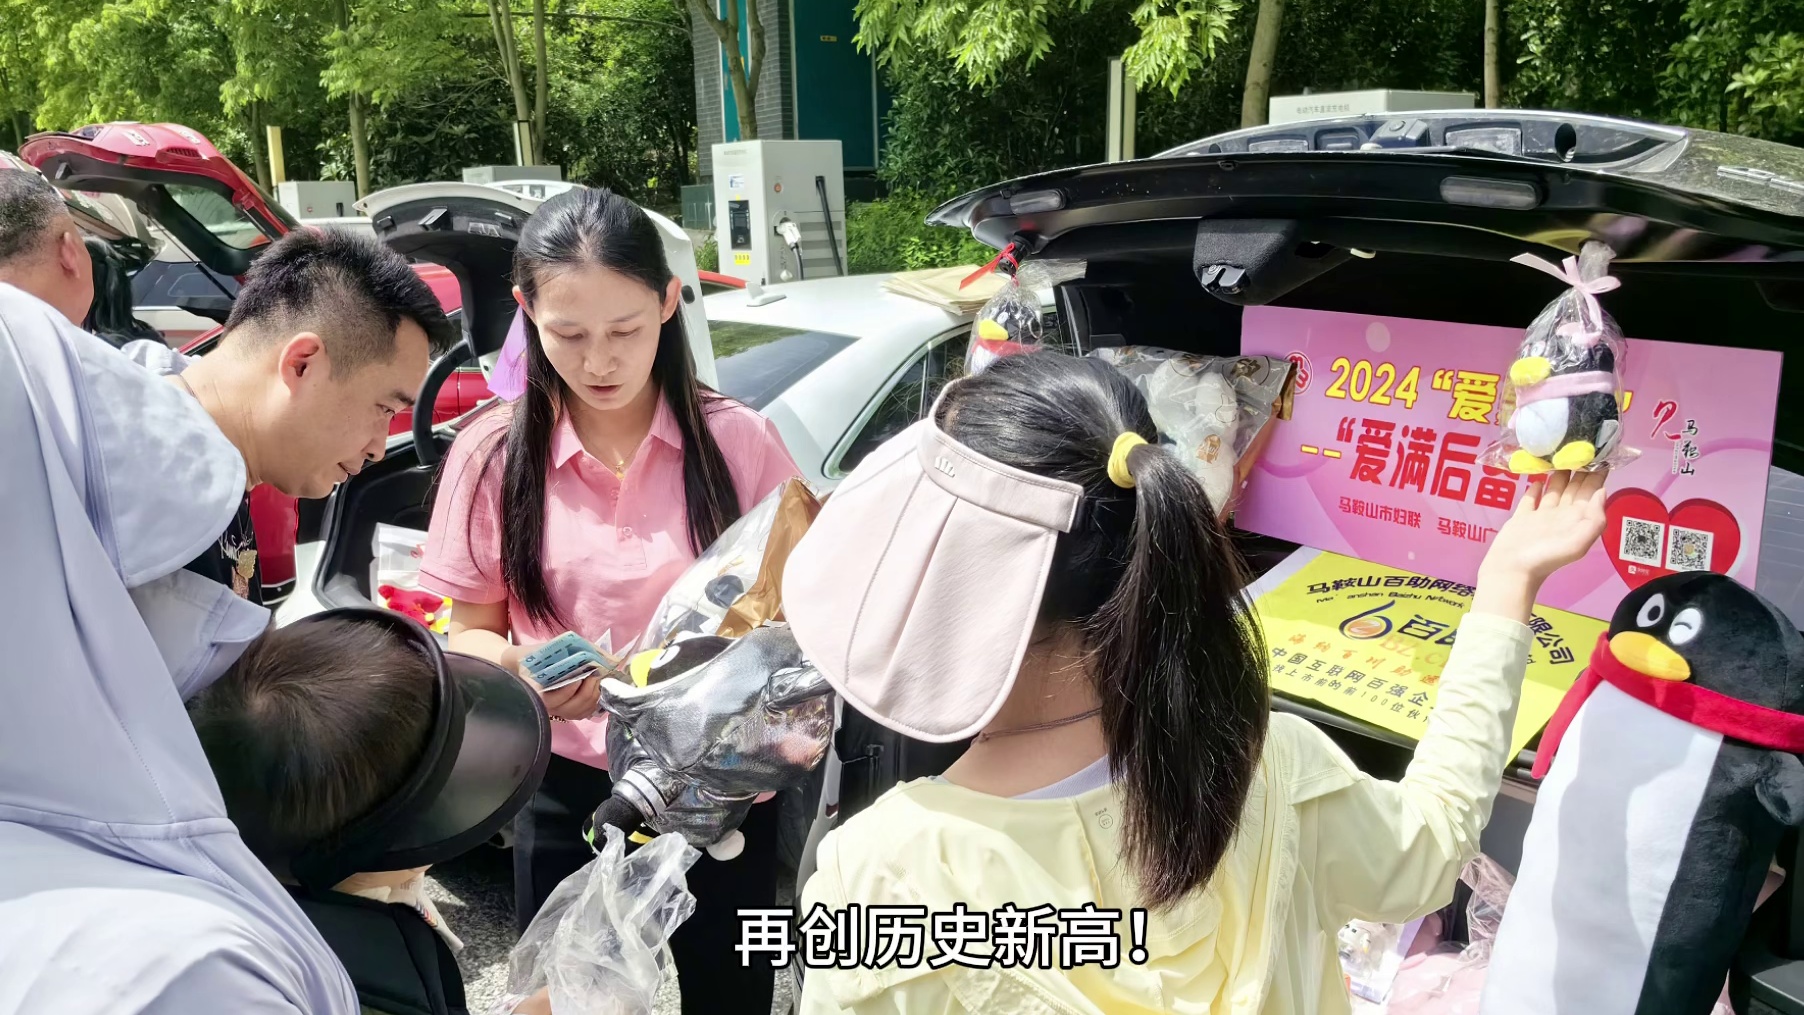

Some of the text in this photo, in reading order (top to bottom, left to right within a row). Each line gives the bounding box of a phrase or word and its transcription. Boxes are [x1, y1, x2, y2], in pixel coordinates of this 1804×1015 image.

[1325, 356, 1421, 410] 2024
[1681, 419, 1700, 476] 马鞍山
[1338, 496, 1422, 529] 马鞍山市妇联
[1272, 647, 1434, 710] 中国互联网百强企
